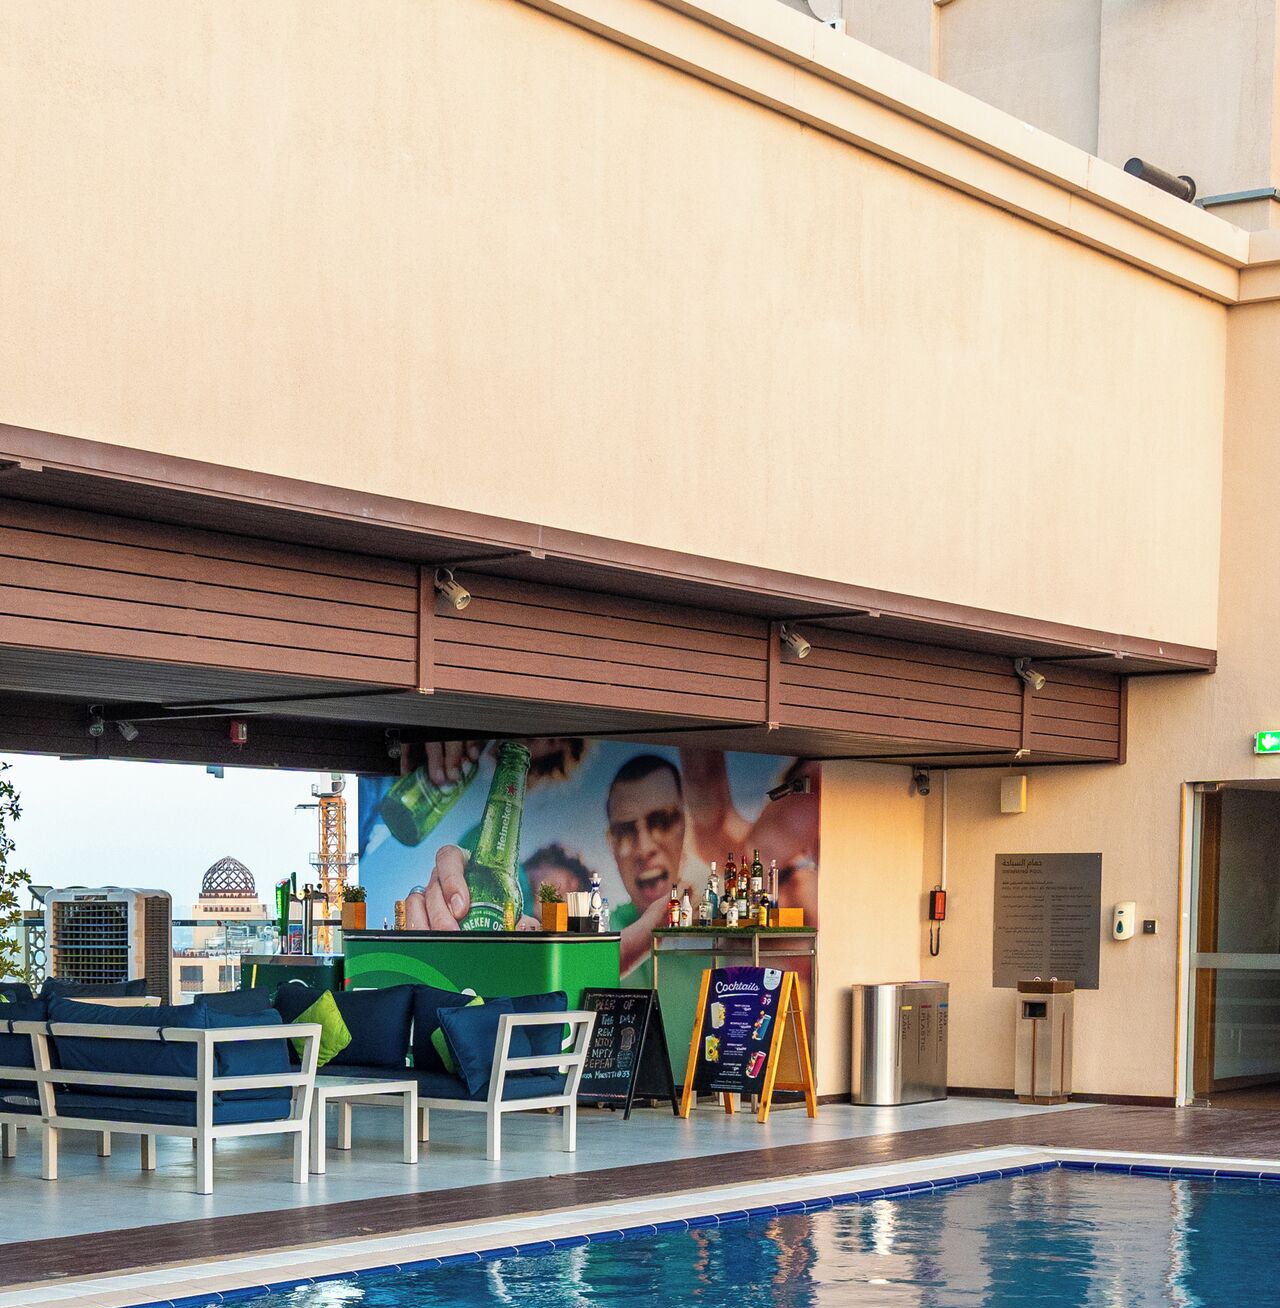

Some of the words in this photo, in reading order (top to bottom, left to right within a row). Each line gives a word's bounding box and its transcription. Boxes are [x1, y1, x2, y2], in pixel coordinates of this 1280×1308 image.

[496, 800, 512, 851] Heineken
[463, 917, 490, 931] NEKEN
[715, 980, 760, 994] Cocktails
[623, 999, 635, 1010] OF
[762, 998, 771, 1006] 39
[601, 1014, 614, 1025] THE
[619, 1014, 637, 1024] DAY
